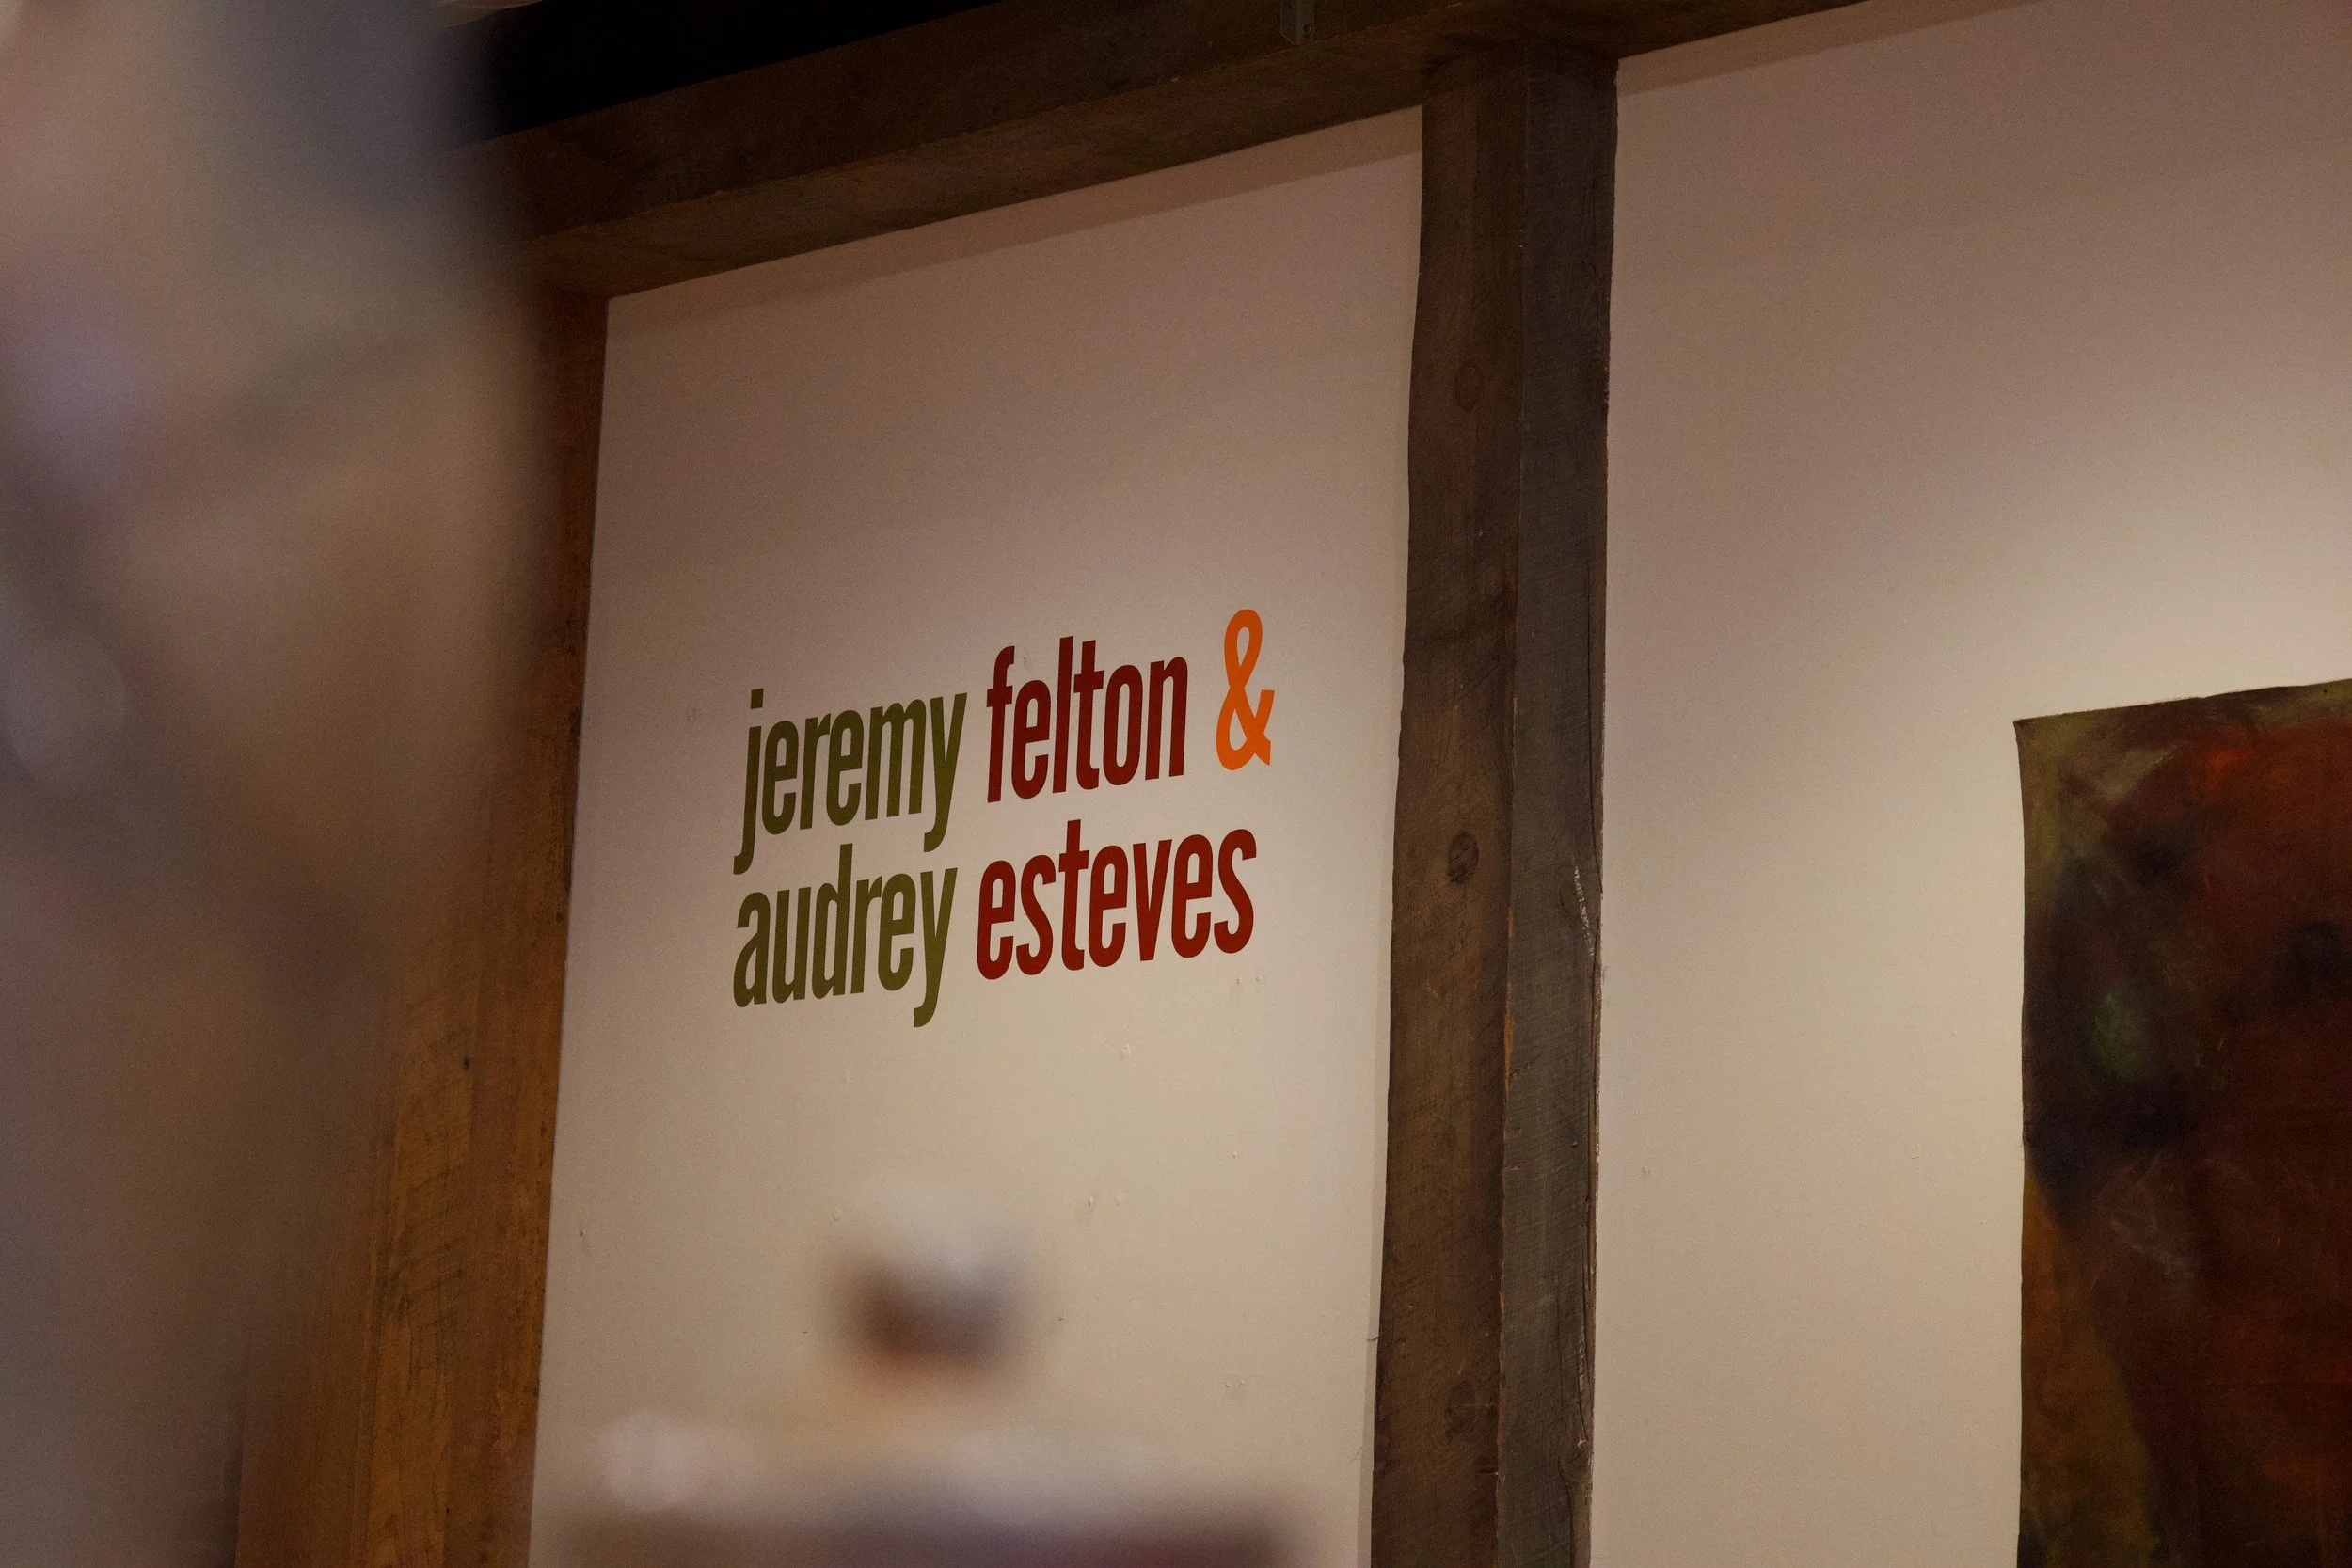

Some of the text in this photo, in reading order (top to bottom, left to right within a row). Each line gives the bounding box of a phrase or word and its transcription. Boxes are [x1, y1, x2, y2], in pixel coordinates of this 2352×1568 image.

[733, 608, 1276, 875] jeremy felton &
[733, 818, 1257, 1028] audrey esteves
